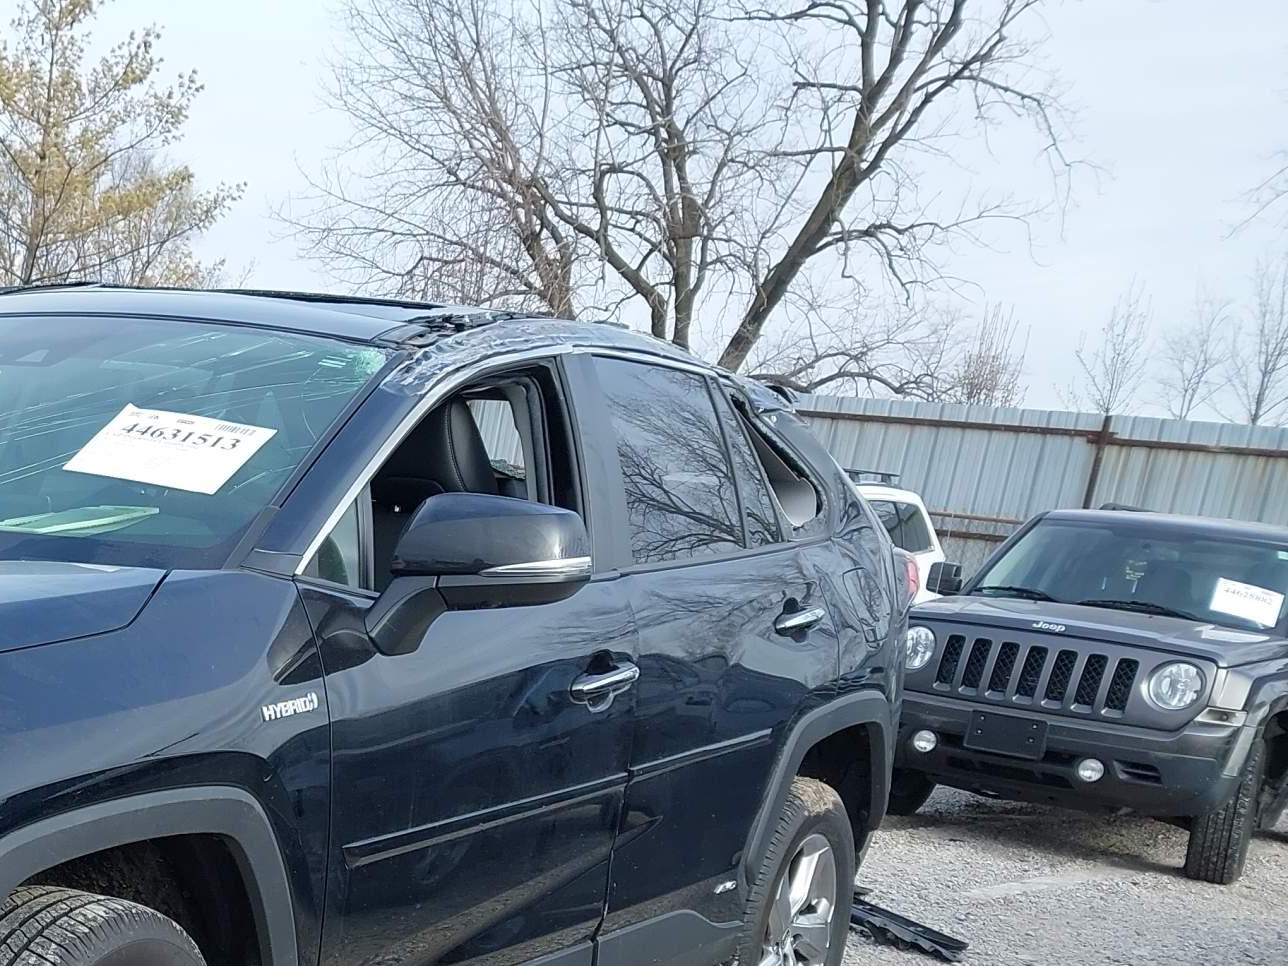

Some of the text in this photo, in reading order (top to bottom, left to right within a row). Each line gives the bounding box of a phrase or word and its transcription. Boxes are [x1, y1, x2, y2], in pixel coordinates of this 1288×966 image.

[122, 422, 241, 450] 44631513
[1032, 621, 1066, 632] Jeep
[262, 695, 314, 721] HYBRID
